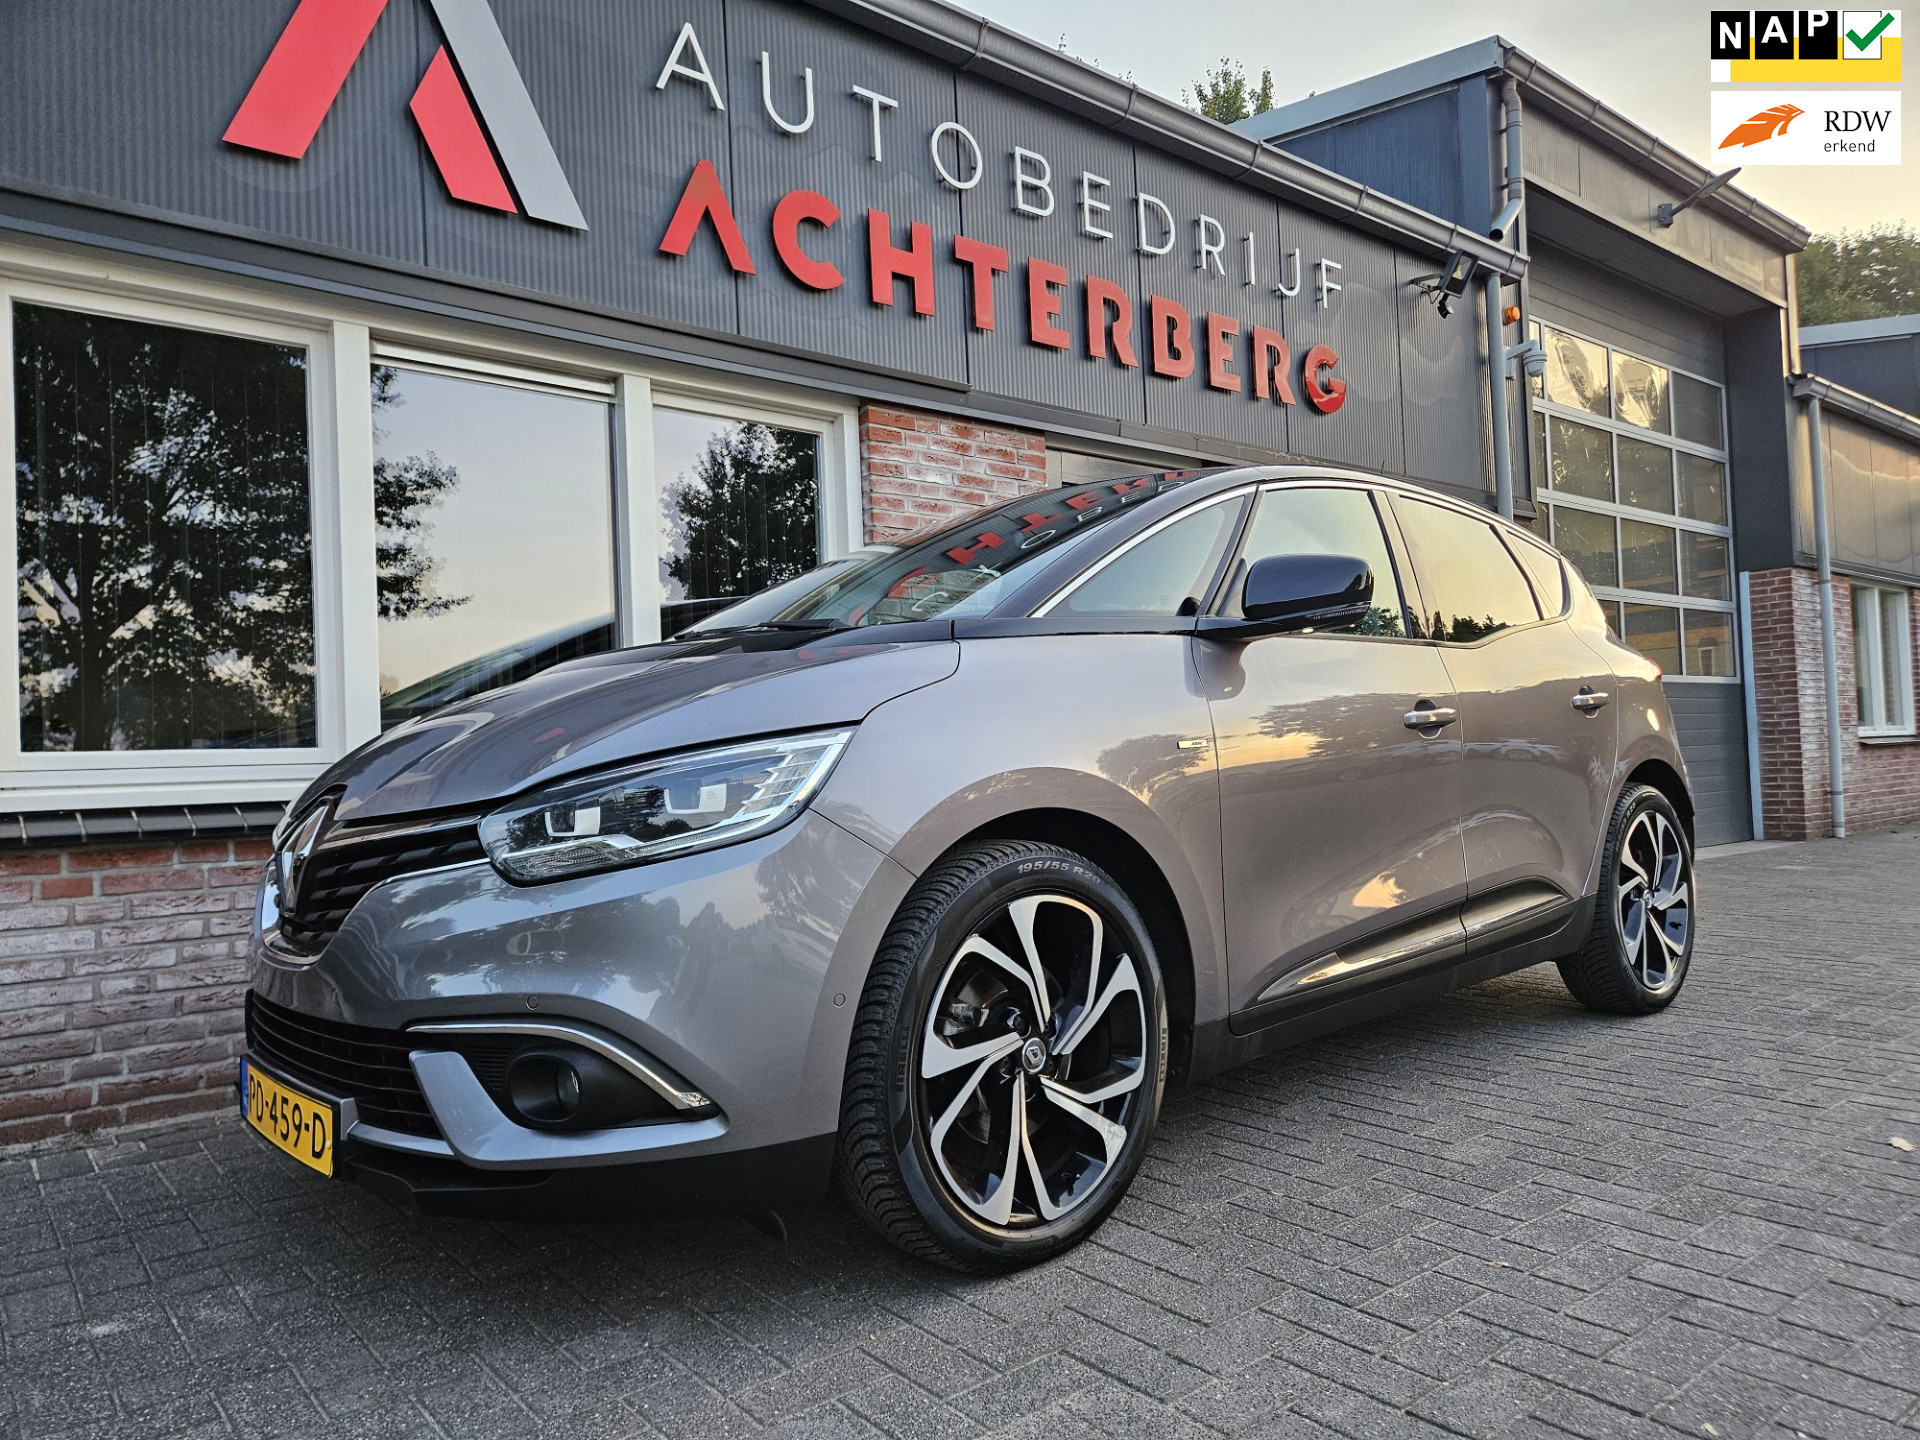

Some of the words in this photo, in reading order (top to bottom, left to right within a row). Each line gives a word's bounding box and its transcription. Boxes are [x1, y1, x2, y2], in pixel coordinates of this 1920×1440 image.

[655, 22, 1343, 309] AUTOBEDRIJF
[659, 160, 1347, 414] ACHTERBERG
[1017, 861, 1070, 874] 195/55
[249, 1073, 327, 1159] PD-459-D
